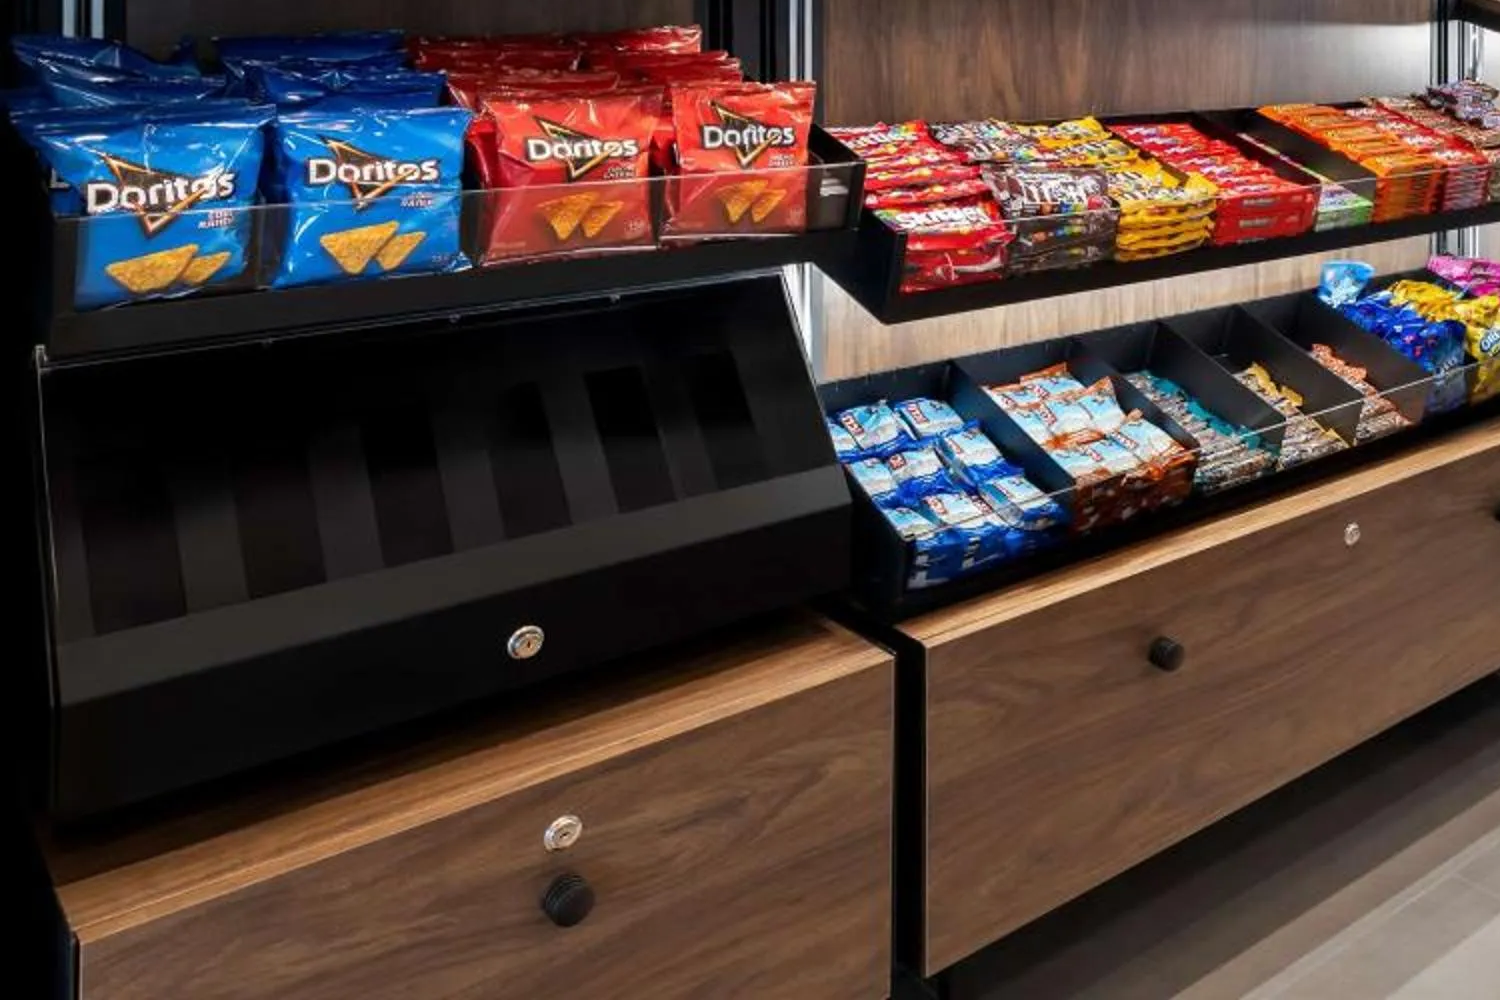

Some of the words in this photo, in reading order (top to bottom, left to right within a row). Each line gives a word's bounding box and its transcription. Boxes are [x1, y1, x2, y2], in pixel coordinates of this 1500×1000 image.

[704, 125, 796, 148] Doritos
[527, 138, 639, 161] Doritos
[308, 158, 440, 185] Doritos
[87, 170, 236, 215] Doritos
